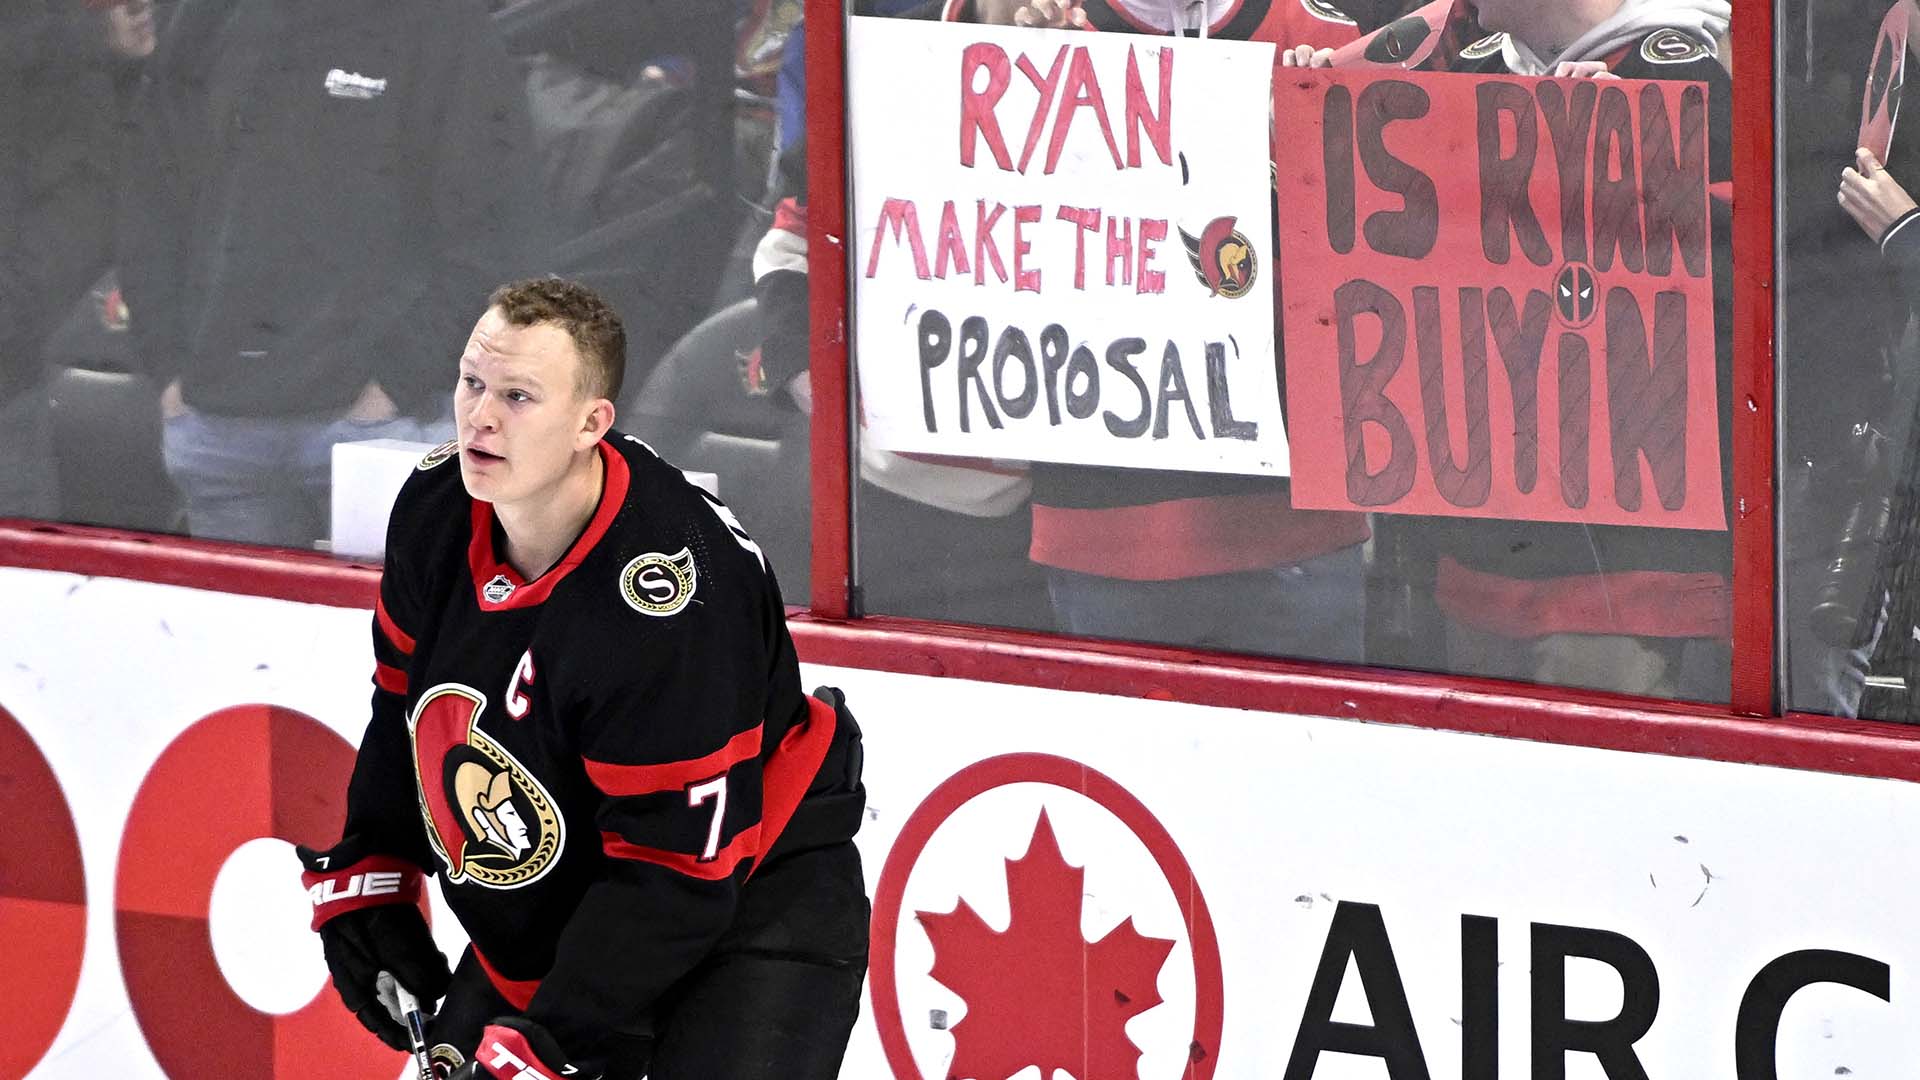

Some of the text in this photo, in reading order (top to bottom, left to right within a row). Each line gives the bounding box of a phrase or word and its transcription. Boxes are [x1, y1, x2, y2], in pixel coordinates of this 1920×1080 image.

[960, 42, 1189, 185] RYAN,
[1322, 79, 1707, 278] IS RYAN
[865, 197, 1169, 294] MAKE THE
[505, 647, 535, 721] C
[315, 856, 331, 870] 7
[684, 774, 729, 861] 7
[1283, 899, 1660, 1080] AIR
